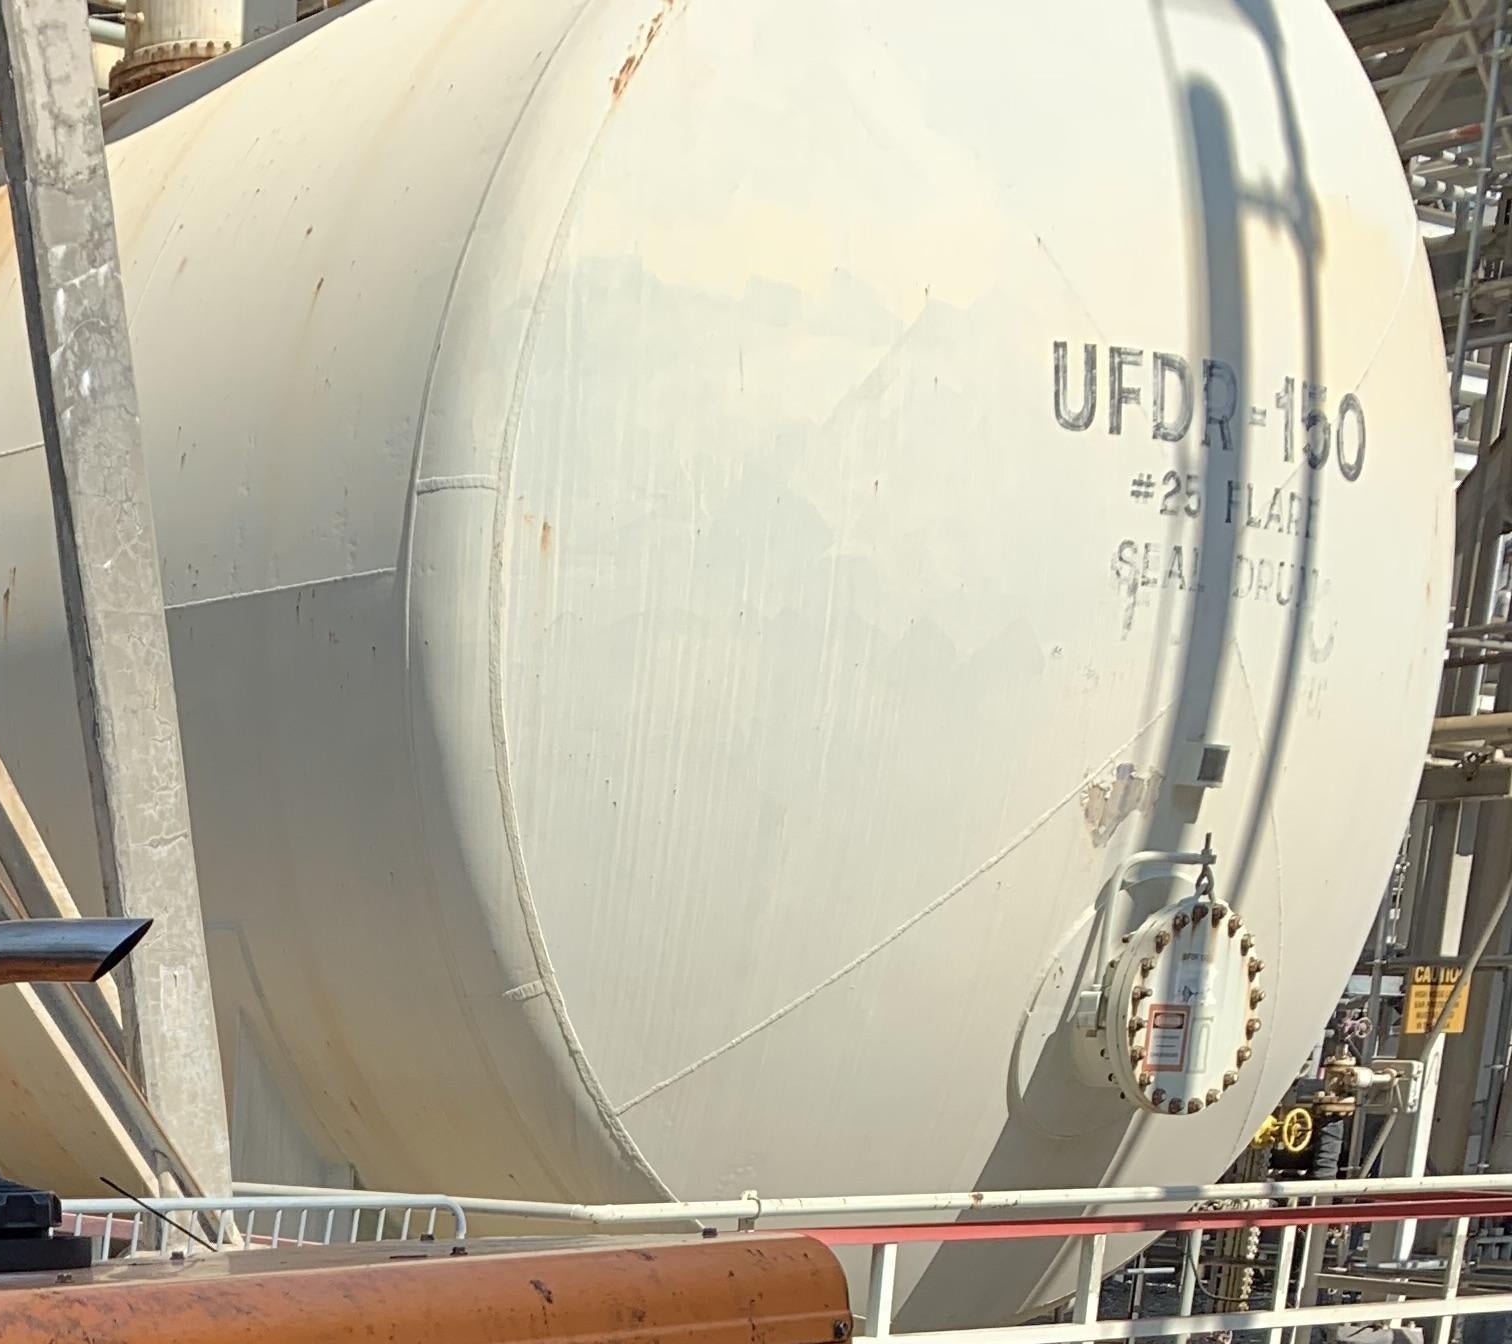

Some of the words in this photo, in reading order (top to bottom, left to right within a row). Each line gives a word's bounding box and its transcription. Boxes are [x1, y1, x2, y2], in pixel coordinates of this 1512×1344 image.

[1053, 339, 1366, 483] UFDR-150
[1130, 469, 1202, 518] #25
[1414, 966, 1464, 983] CAUTIO
